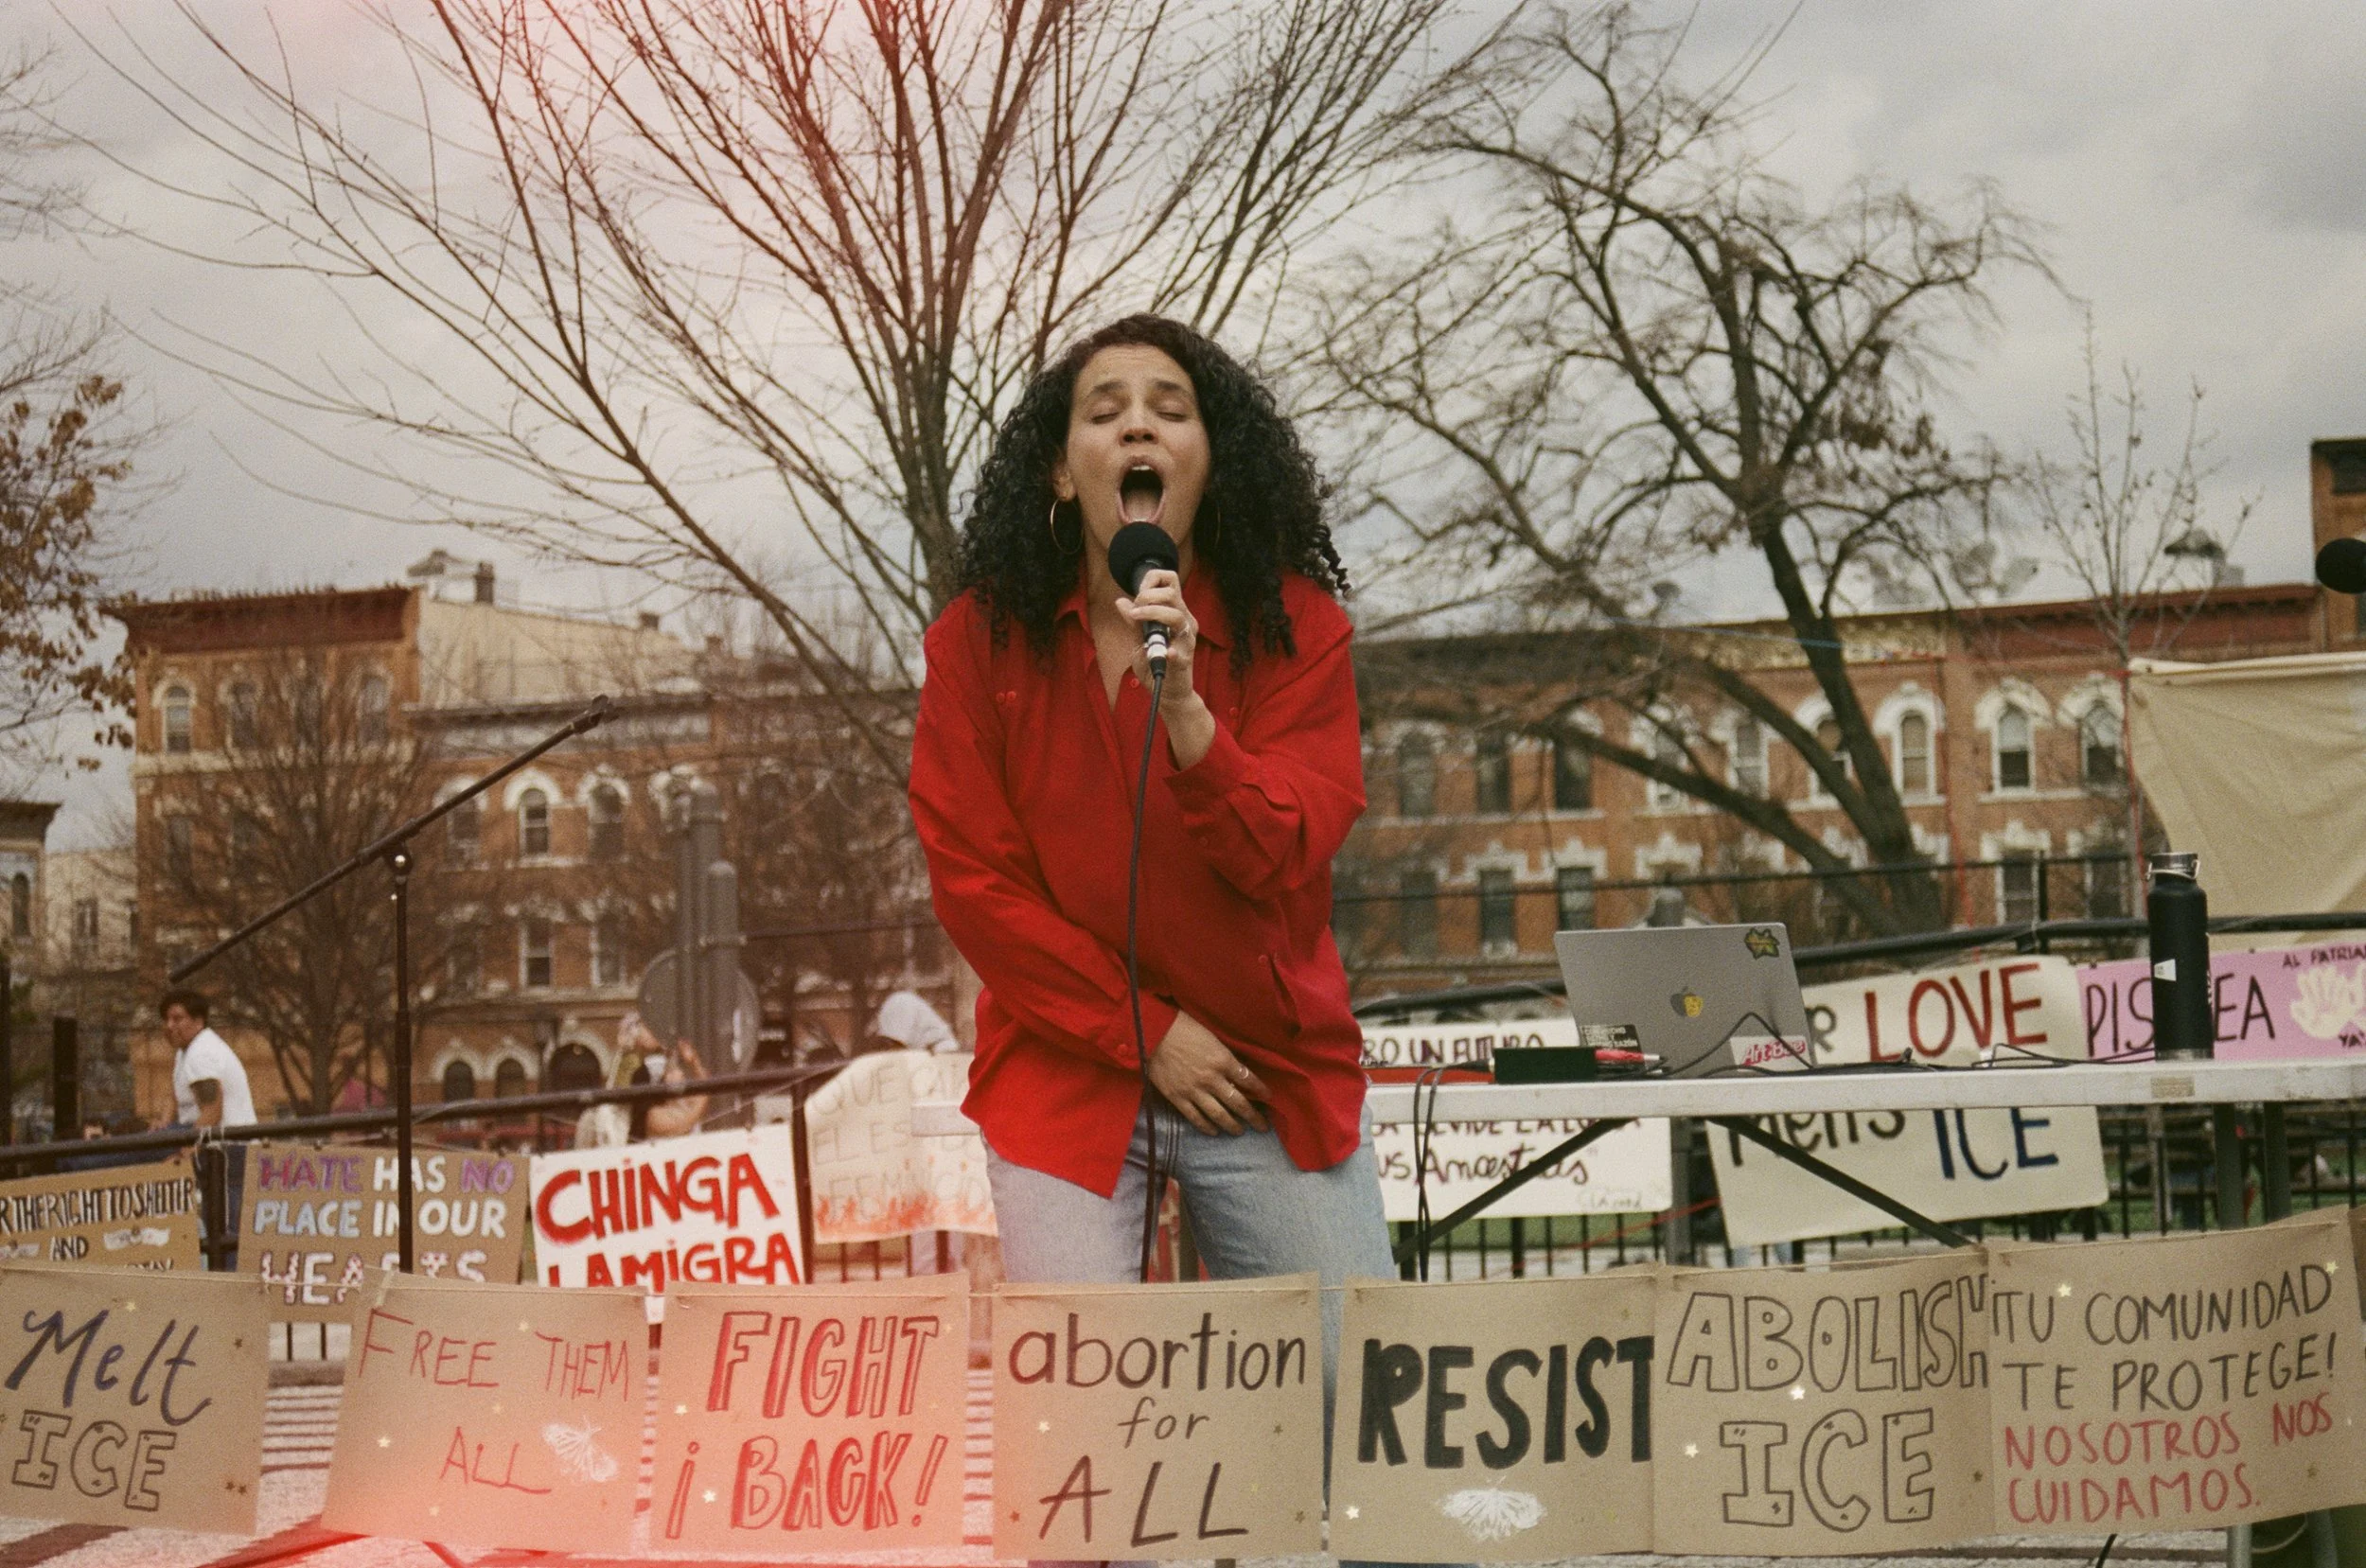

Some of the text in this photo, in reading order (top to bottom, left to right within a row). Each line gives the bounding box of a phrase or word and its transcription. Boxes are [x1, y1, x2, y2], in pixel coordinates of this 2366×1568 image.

[2282, 944, 2366, 969] AL PATRIA
[1863, 962, 2047, 1062] LOVE
[2085, 973, 2275, 1057] PISEA
[258, 1150, 515, 1194] HATE HAS NO
[1933, 1106, 2059, 1180] ICE
[50, 1235, 89, 1261] AND
[255, 1199, 363, 1238] PLACE
[418, 1198, 506, 1239] OUR
[1667, 1273, 1988, 1393] ABOLISH
[2085, 1263, 2332, 1346] COMUNIDAD
[4, 1309, 212, 1426] Melt
[358, 1308, 628, 1401] FREE THEM
[706, 1311, 939, 1418] FIGHT
[1009, 1313, 1305, 1390] abortion
[2002, 1331, 2337, 1411] TE PROTEGE!
[1118, 1397, 1209, 1449] for
[1358, 1336, 1654, 1470] RESIST
[2004, 1391, 2333, 1471] NOSOTROS NOS
[11, 1409, 177, 1511] ICE
[439, 1426, 552, 1494] ALL
[1720, 1407, 1934, 1533] ICE
[2008, 1462, 2262, 1524] CUIDAMOS.
[1039, 1455, 1249, 1547] ALL
